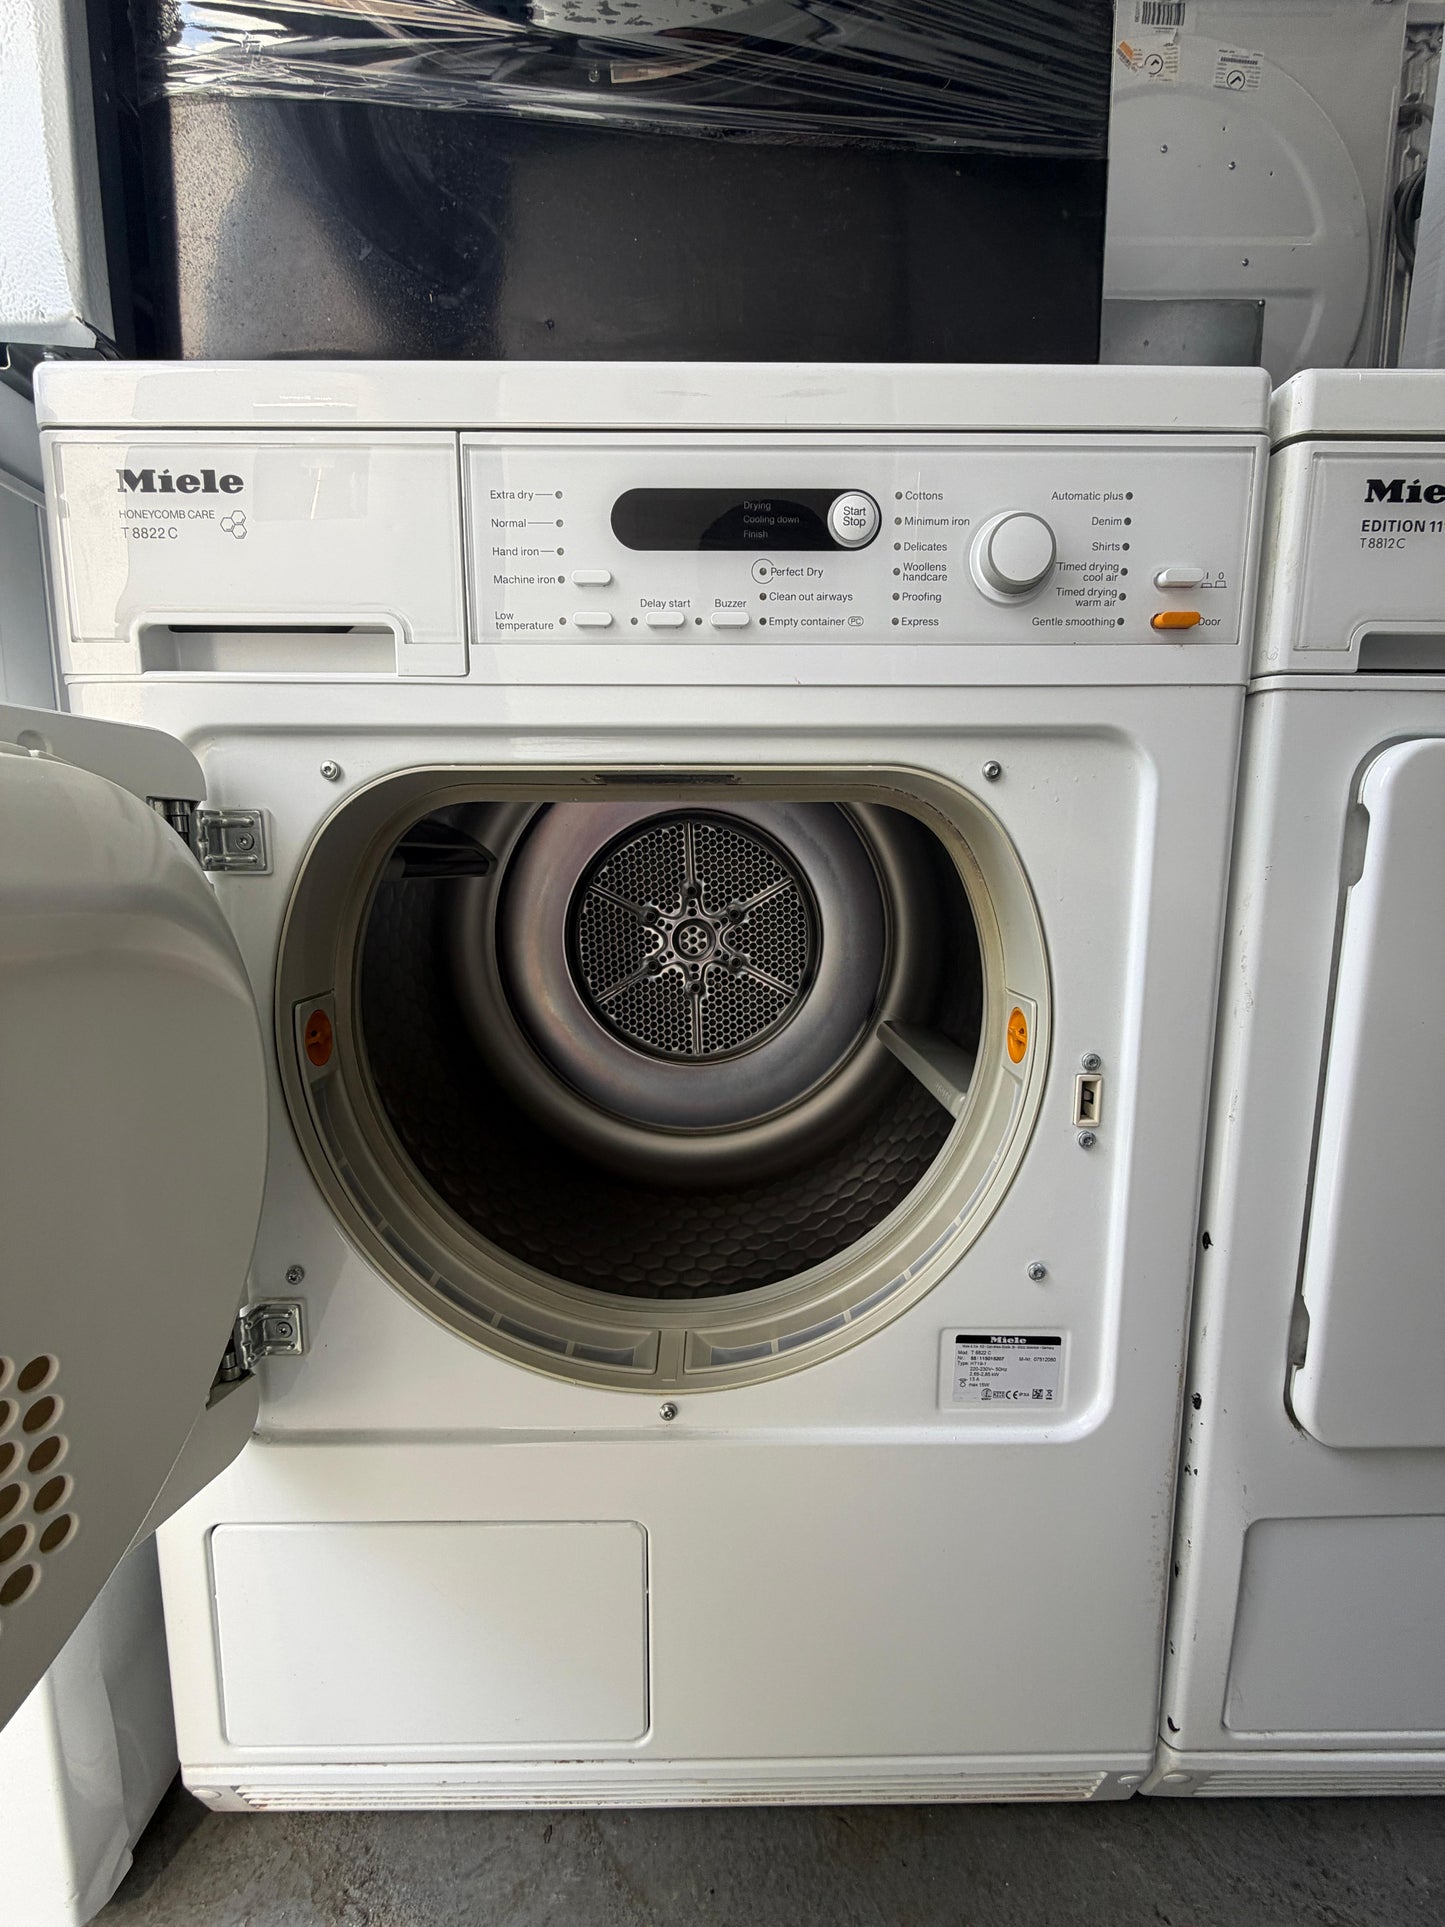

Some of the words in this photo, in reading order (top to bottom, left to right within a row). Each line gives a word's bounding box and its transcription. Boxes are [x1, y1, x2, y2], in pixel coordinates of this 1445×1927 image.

[116, 468, 245, 494] Miele
[490, 490, 516, 500] Extra
[517, 491, 534, 501] dry
[905, 491, 944, 501] Cottons
[1051, 491, 1101, 501] Automatic
[1103, 492, 1124, 503] plus
[743, 501, 772, 512] Drying
[843, 506, 867, 516] Start
[118, 509, 186, 520] HONEYCOMB
[187, 509, 216, 520] CARE
[491, 518, 527, 528] Normal
[743, 515, 775, 525] Cooling
[777, 515, 800, 524] down
[842, 517, 867, 528] Stop
[904, 516, 950, 526] Minimum
[951, 517, 970, 526] iron
[1091, 517, 1122, 526] Denim
[1361, 519, 1426, 533] EDITION
[743, 530, 768, 539] Finish
[492, 547, 519, 556] Hand
[520, 547, 540, 556] iron
[903, 542, 948, 552] Delicates
[1092, 542, 1120, 551] Shirts
[903, 563, 947, 572] Woollens
[1055, 562, 1088, 571] Timed
[1089, 562, 1119, 574] drying
[770, 567, 805, 577] Perfect
[806, 568, 824, 579] Dry
[902, 572, 948, 582] handcare
[1083, 573, 1102, 582] cool
[1103, 573, 1118, 582] air
[493, 575, 536, 584] Machine
[536, 575, 556, 584] iron
[768, 592, 797, 602] Clean
[798, 593, 815, 602] out
[816, 593, 853, 603] airways
[902, 592, 942, 604] Proofing
[1055, 587, 1086, 597] Timed
[1087, 588, 1118, 599] drying
[640, 599, 667, 610] Delay
[668, 599, 691, 608] start
[714, 599, 747, 608] Buzzer
[1075, 599, 1102, 607] warm
[1103, 598, 1116, 607] air
[495, 611, 514, 620] Low
[495, 621, 554, 631] temperature
[768, 617, 799, 628] Empty
[800, 617, 845, 627] container
[849, 617, 862, 625] PC
[901, 617, 939, 628] Express
[1031, 617, 1064, 627] Gentle
[1065, 617, 1116, 628] smoothing
[1198, 617, 1221, 626] Door
[990, 1336, 1027, 1344] Miele
